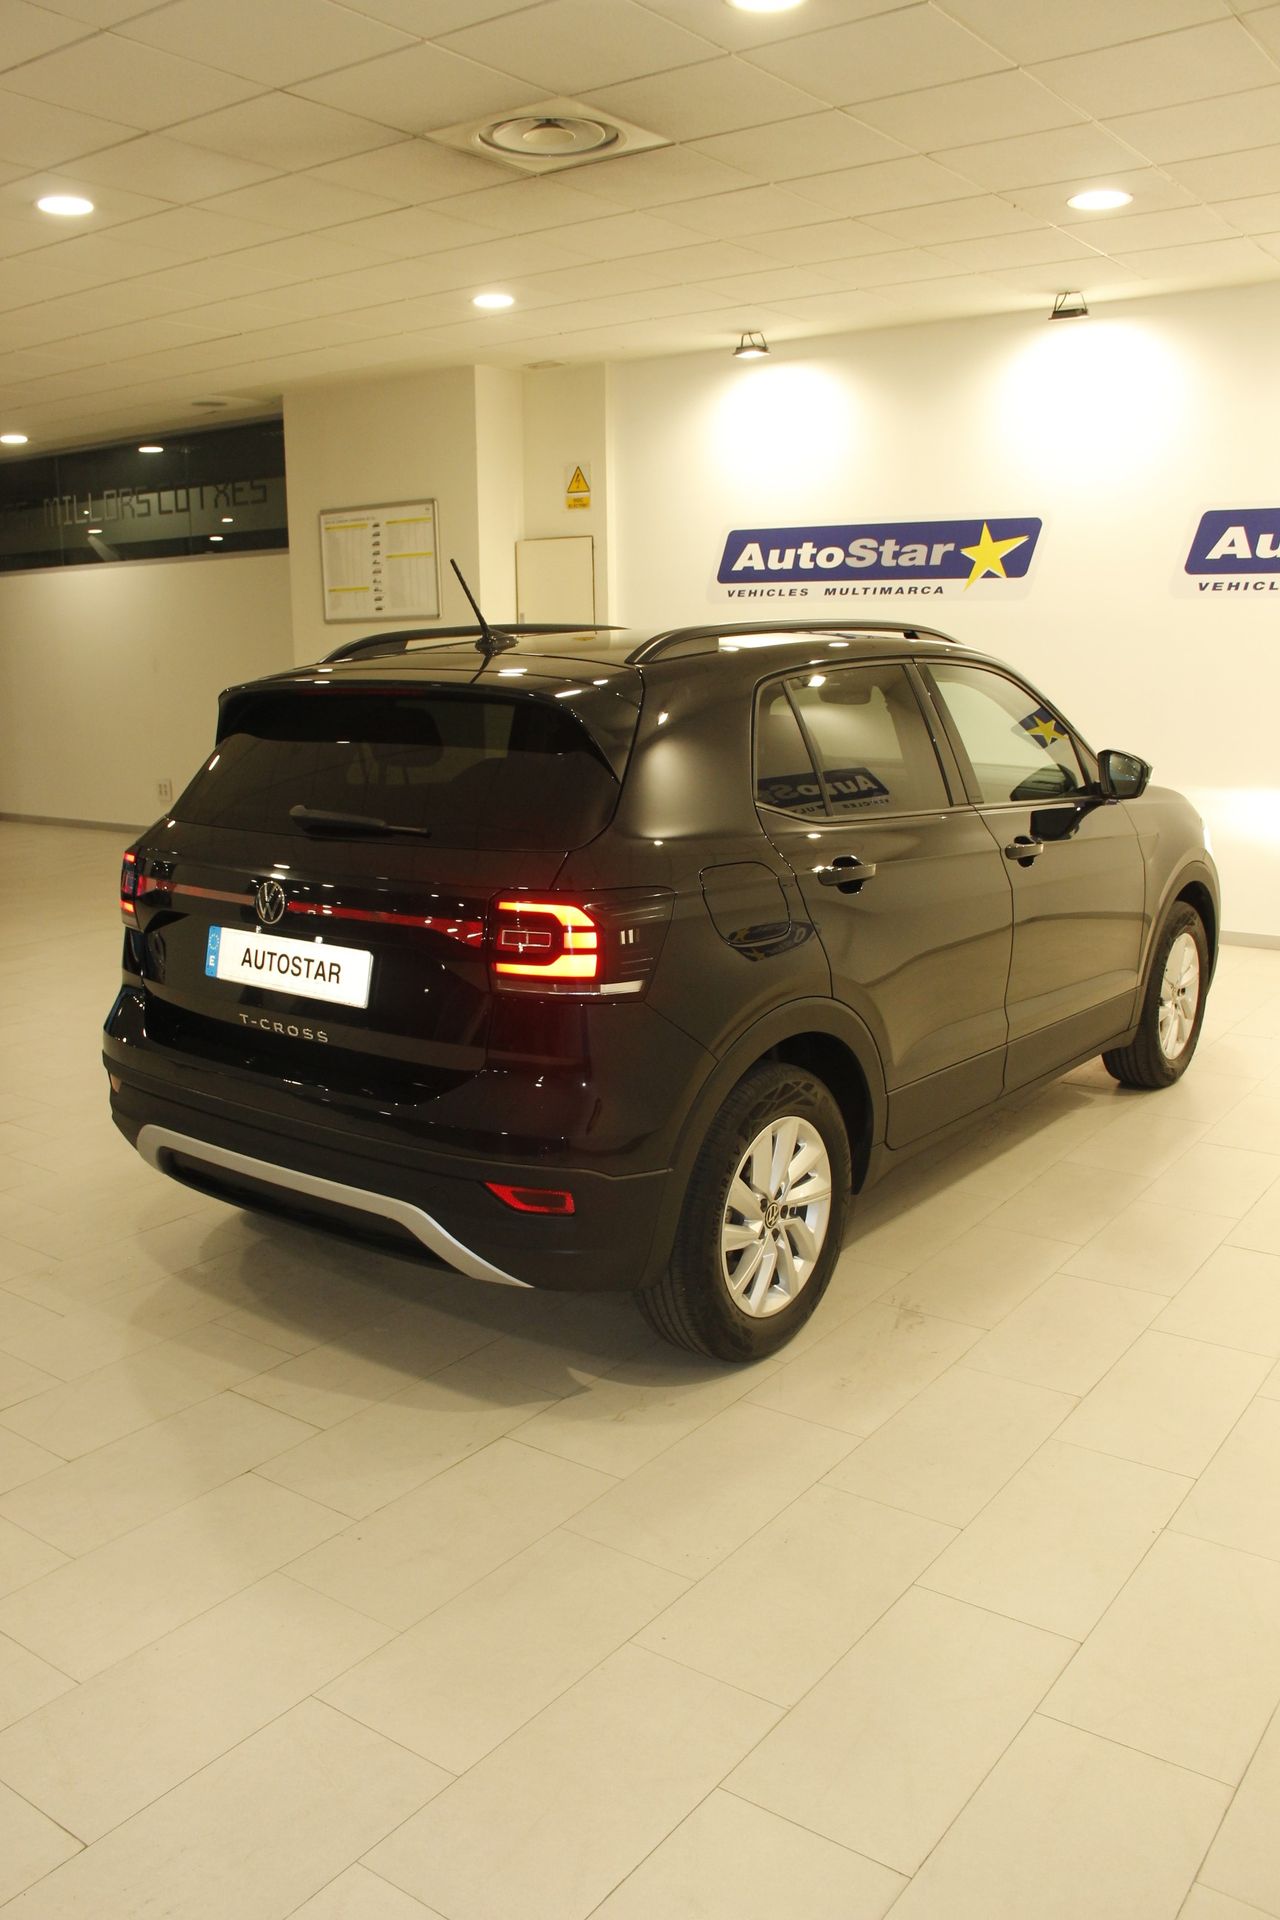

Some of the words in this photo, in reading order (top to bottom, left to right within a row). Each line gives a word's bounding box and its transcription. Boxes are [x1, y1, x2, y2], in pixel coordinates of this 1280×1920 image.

[43, 486, 150, 527] MILLORS
[158, 480, 268, 514] COTXES
[731, 538, 956, 572] AutoStar
[727, 588, 809, 598] VEHICLES
[824, 586, 944, 596] MULTIMARCA
[208, 955, 216, 967] E
[241, 947, 342, 984] AUTOSTAR
[239, 1013, 329, 1043] T-CROSS
